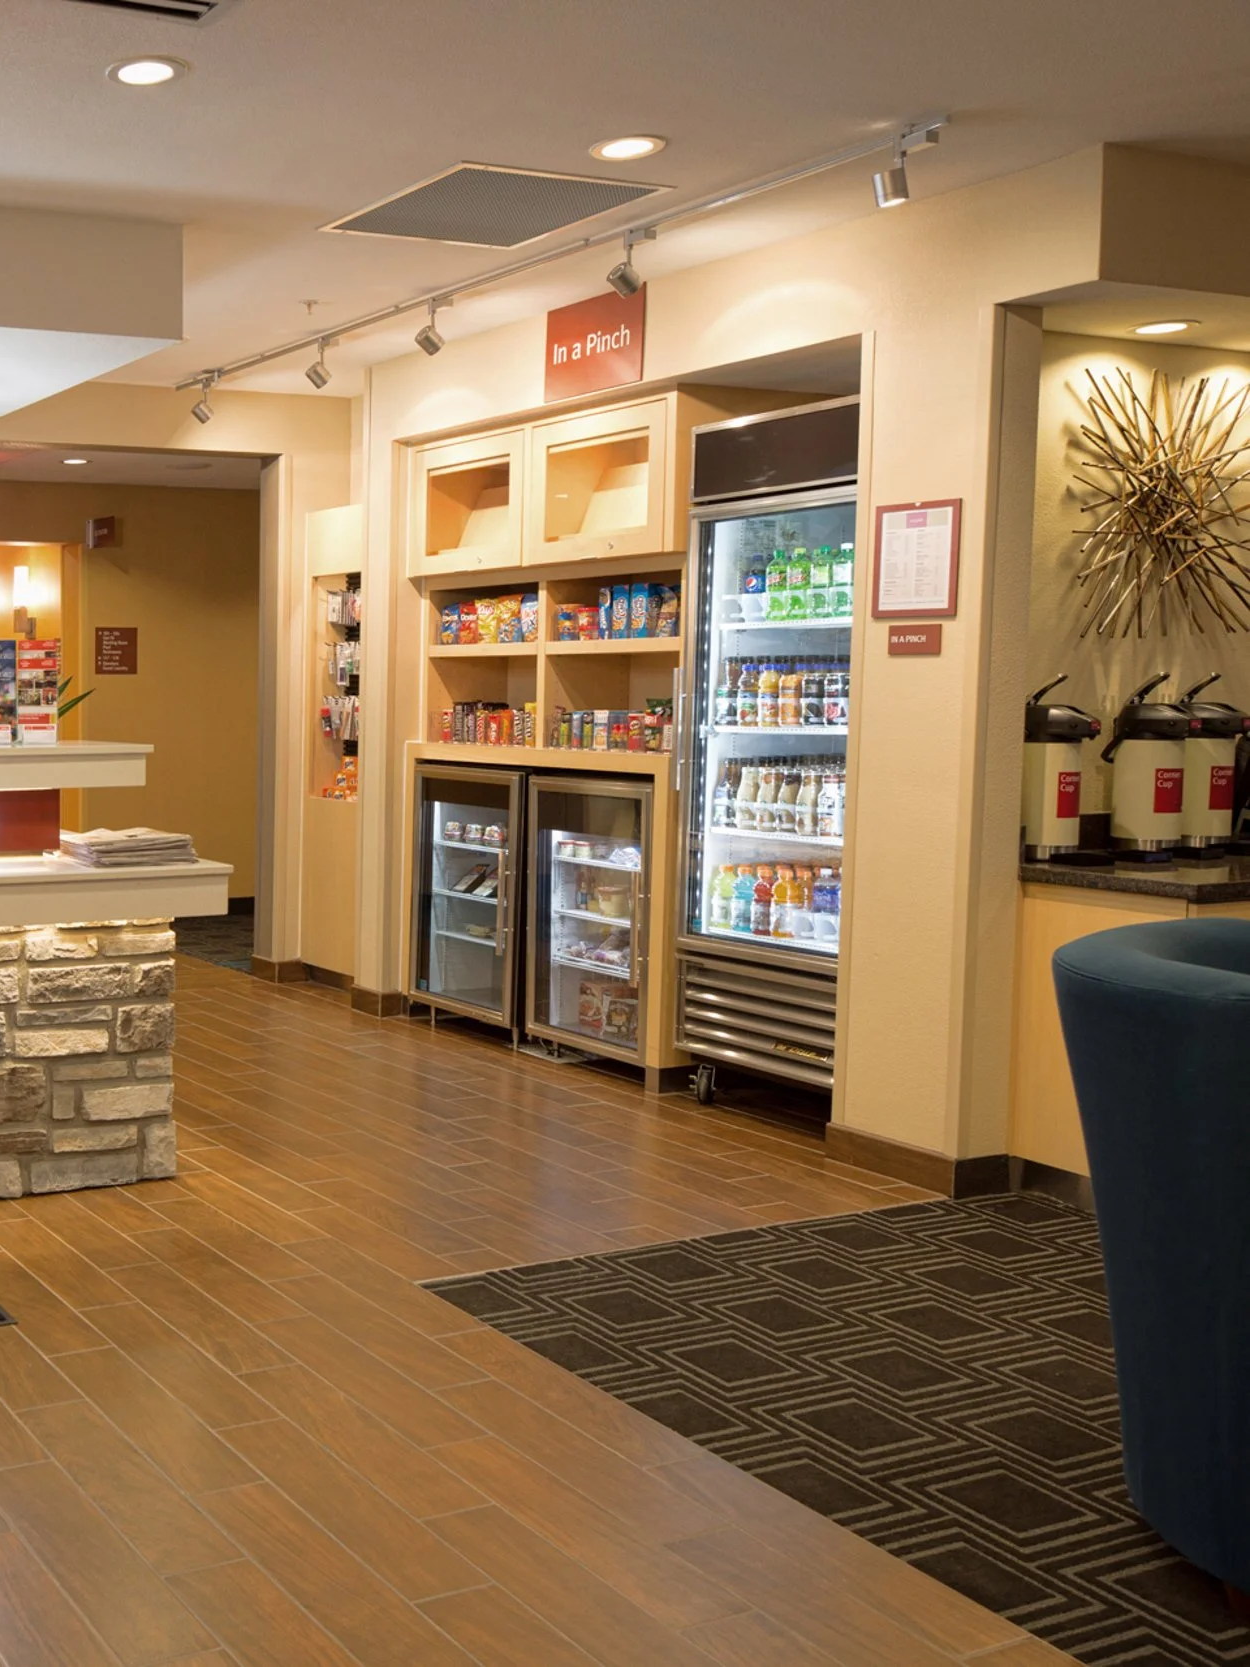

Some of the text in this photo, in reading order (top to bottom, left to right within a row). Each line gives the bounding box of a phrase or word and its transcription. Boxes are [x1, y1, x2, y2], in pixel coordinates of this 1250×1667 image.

[553, 324, 630, 365] In a Pinch
[906, 635, 926, 643] PINCH
[1157, 780, 1173, 788] Cup
[1212, 778, 1227, 786] Cup
[1060, 784, 1075, 792] Cup
